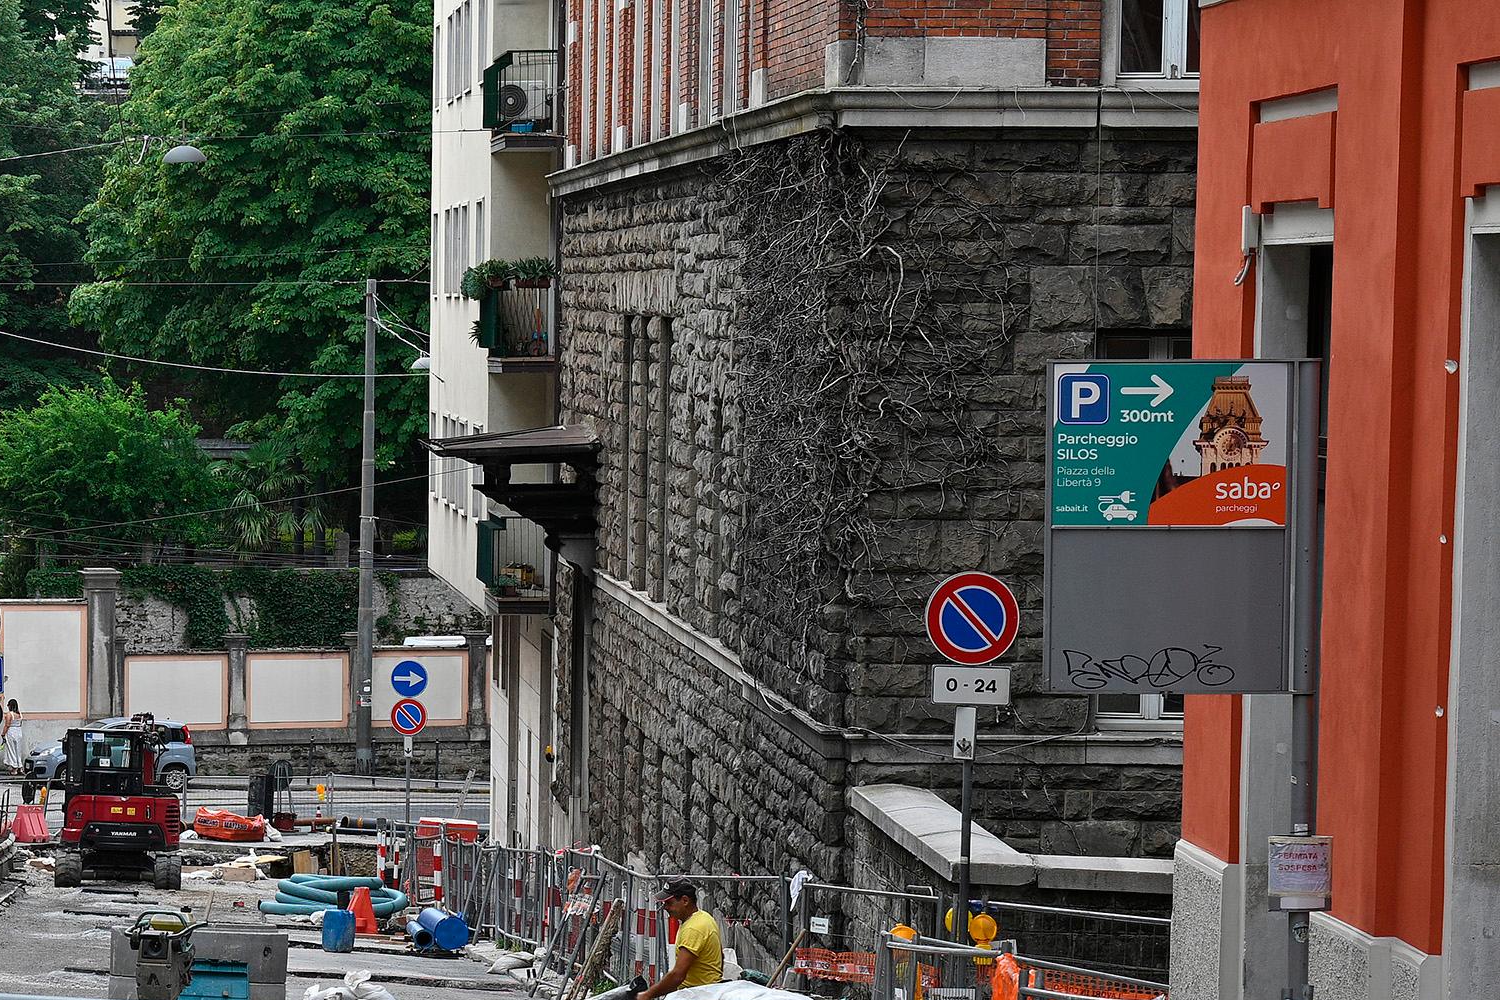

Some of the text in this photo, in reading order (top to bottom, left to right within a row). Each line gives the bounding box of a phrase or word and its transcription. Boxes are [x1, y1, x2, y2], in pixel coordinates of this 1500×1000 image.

[1071, 381, 1101, 418] P
[1120, 409, 1175, 423] 300mt
[1057, 432, 1138, 447] Parcheggio
[1057, 448, 1098, 460] SILOS
[1057, 466, 1115, 475] Piazza della
[1057, 477, 1101, 487] Libertà 9
[1215, 476, 1271, 500] saba
[1215, 504, 1258, 514] parcheggi
[974, 678, 998, 693] 24
[1278, 852, 1318, 860] FERMATA
